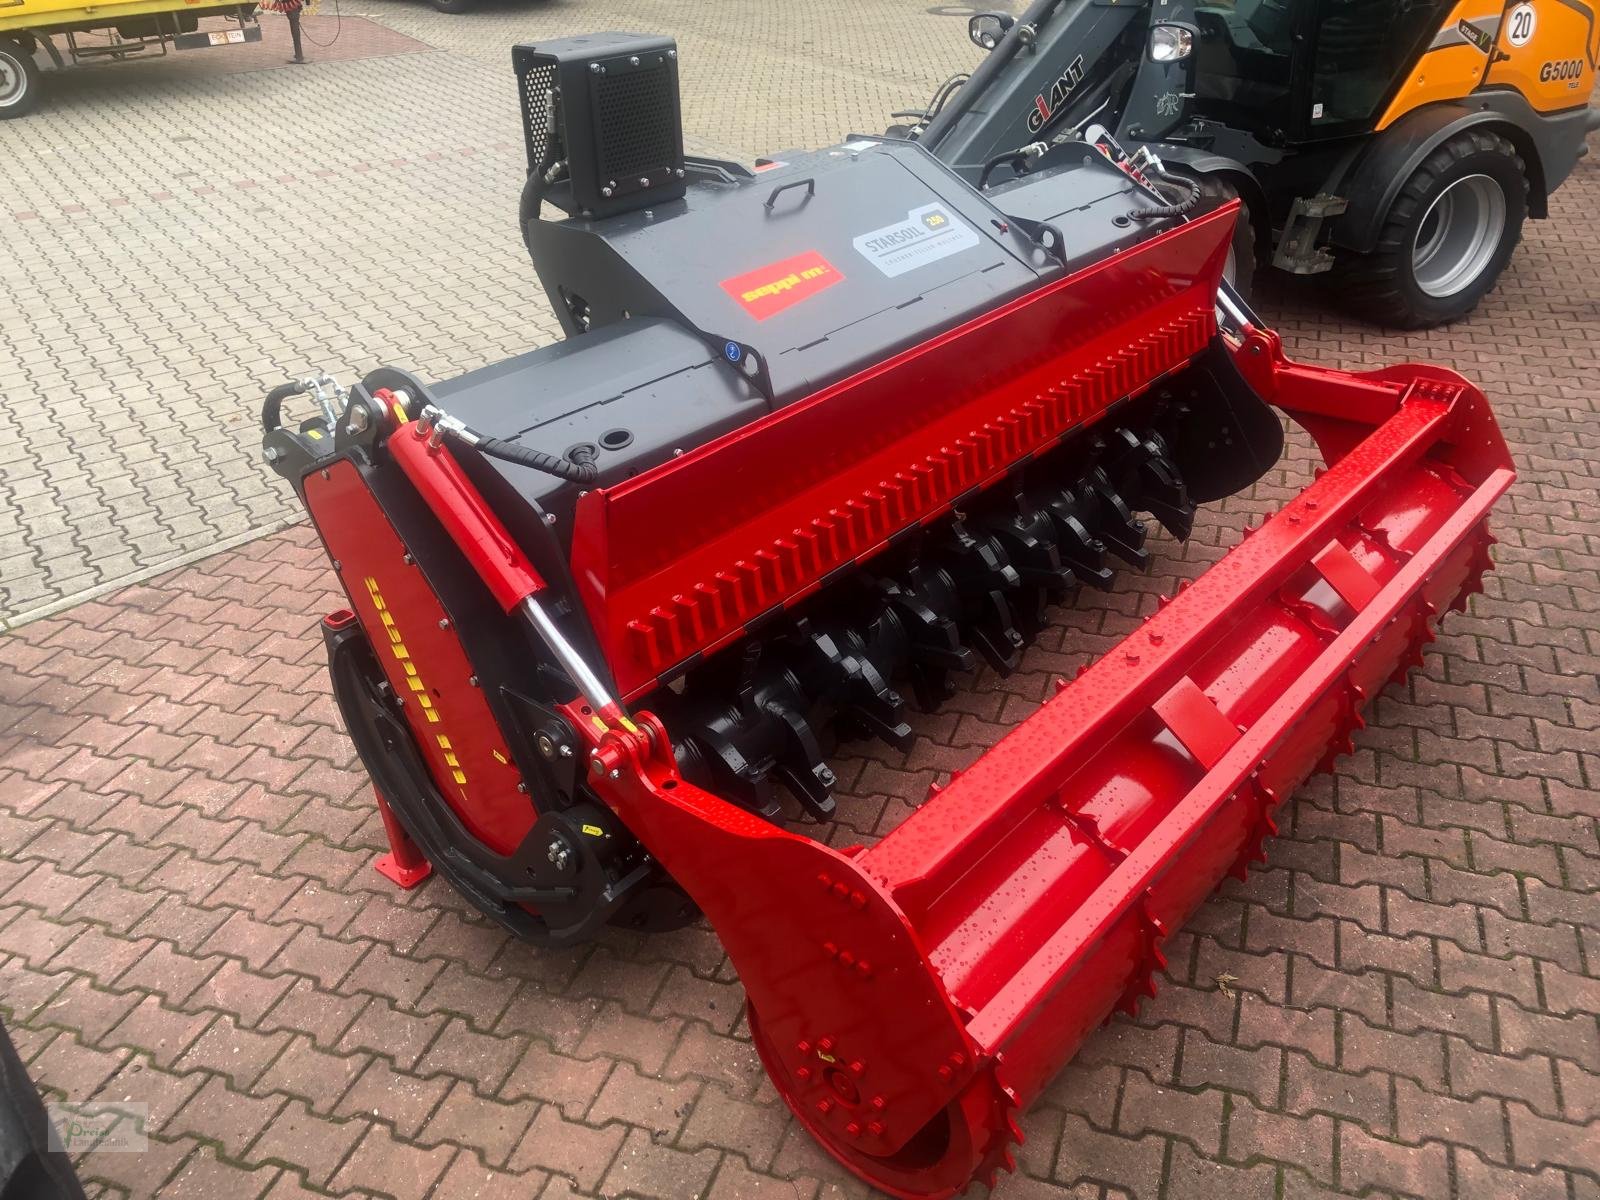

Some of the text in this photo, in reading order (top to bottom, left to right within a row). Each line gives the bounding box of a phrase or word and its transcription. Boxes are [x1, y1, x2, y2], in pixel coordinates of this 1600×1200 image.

[1460, 25, 1479, 42] STAGE
[1512, 12, 1532, 39] 20
[1540, 59, 1583, 82] G5000
[1027, 54, 1085, 134] GIANT
[864, 225, 926, 253] STARSOIL
